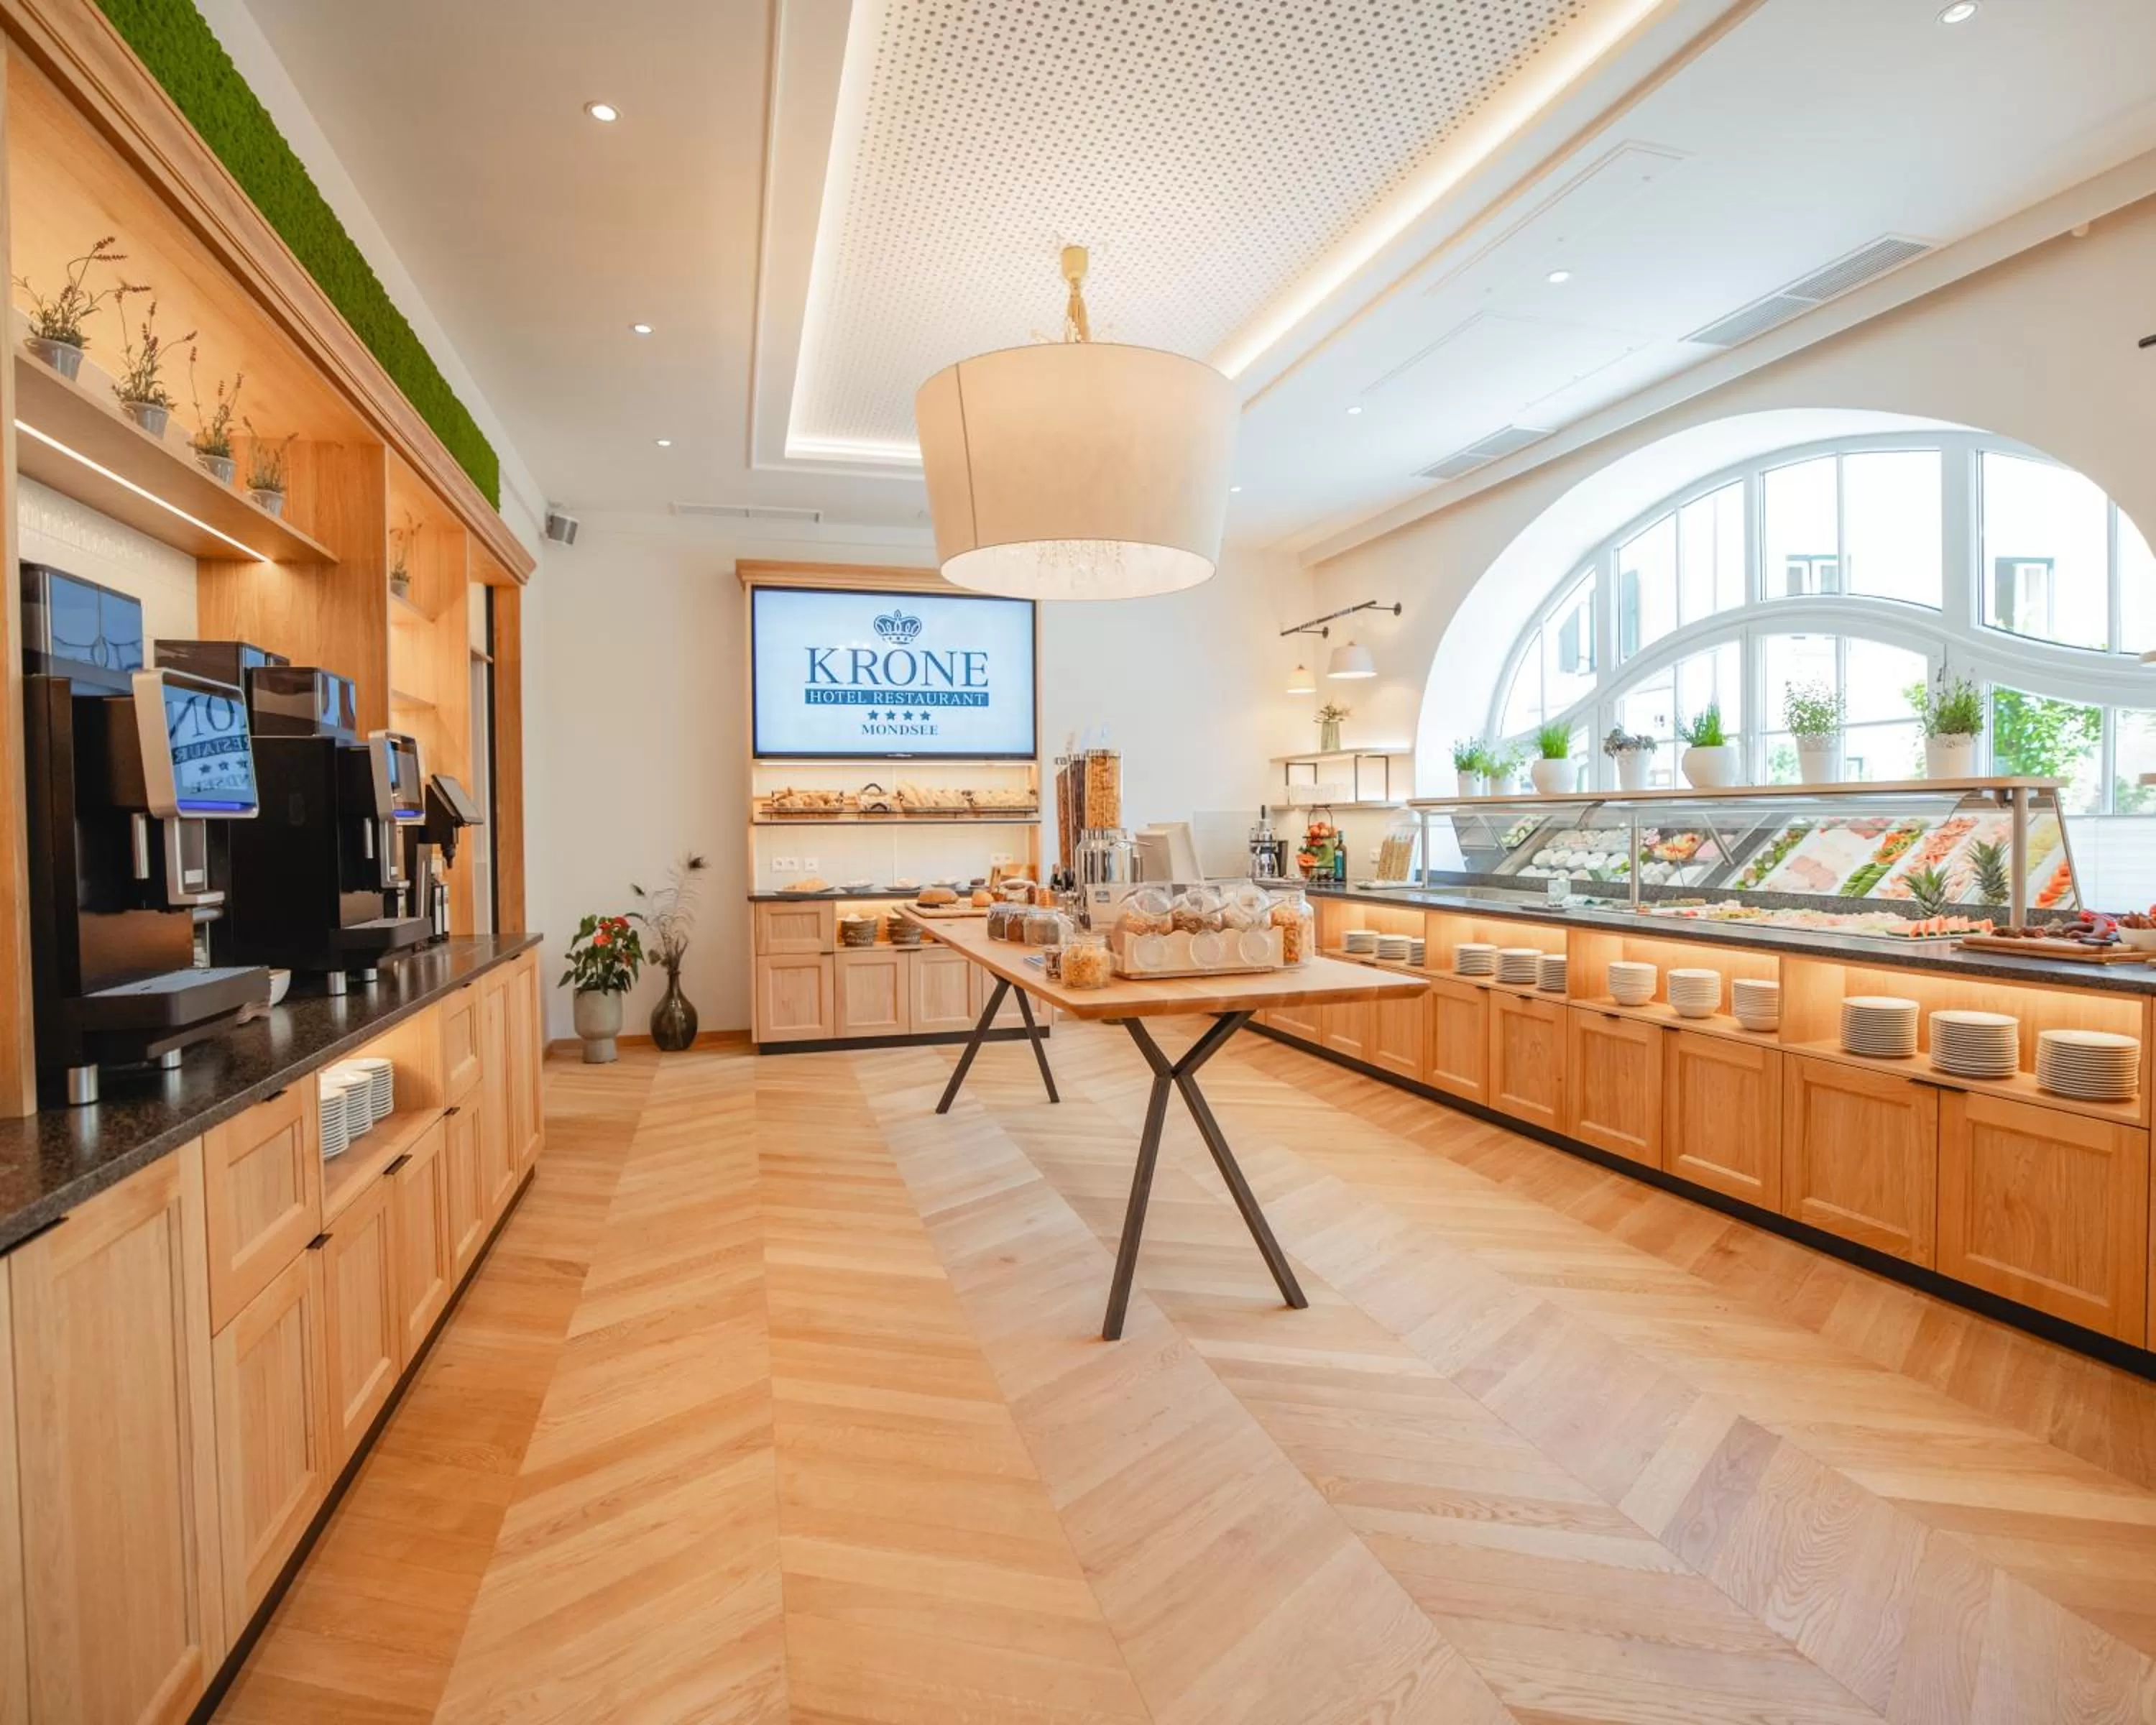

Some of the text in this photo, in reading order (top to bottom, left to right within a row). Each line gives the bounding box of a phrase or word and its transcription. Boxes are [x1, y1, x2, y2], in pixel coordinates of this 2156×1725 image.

[804, 647, 989, 688] KRONE
[809, 690, 985, 706] HOTEL RESTAURANT
[862, 724, 939, 736] MONDSEE
